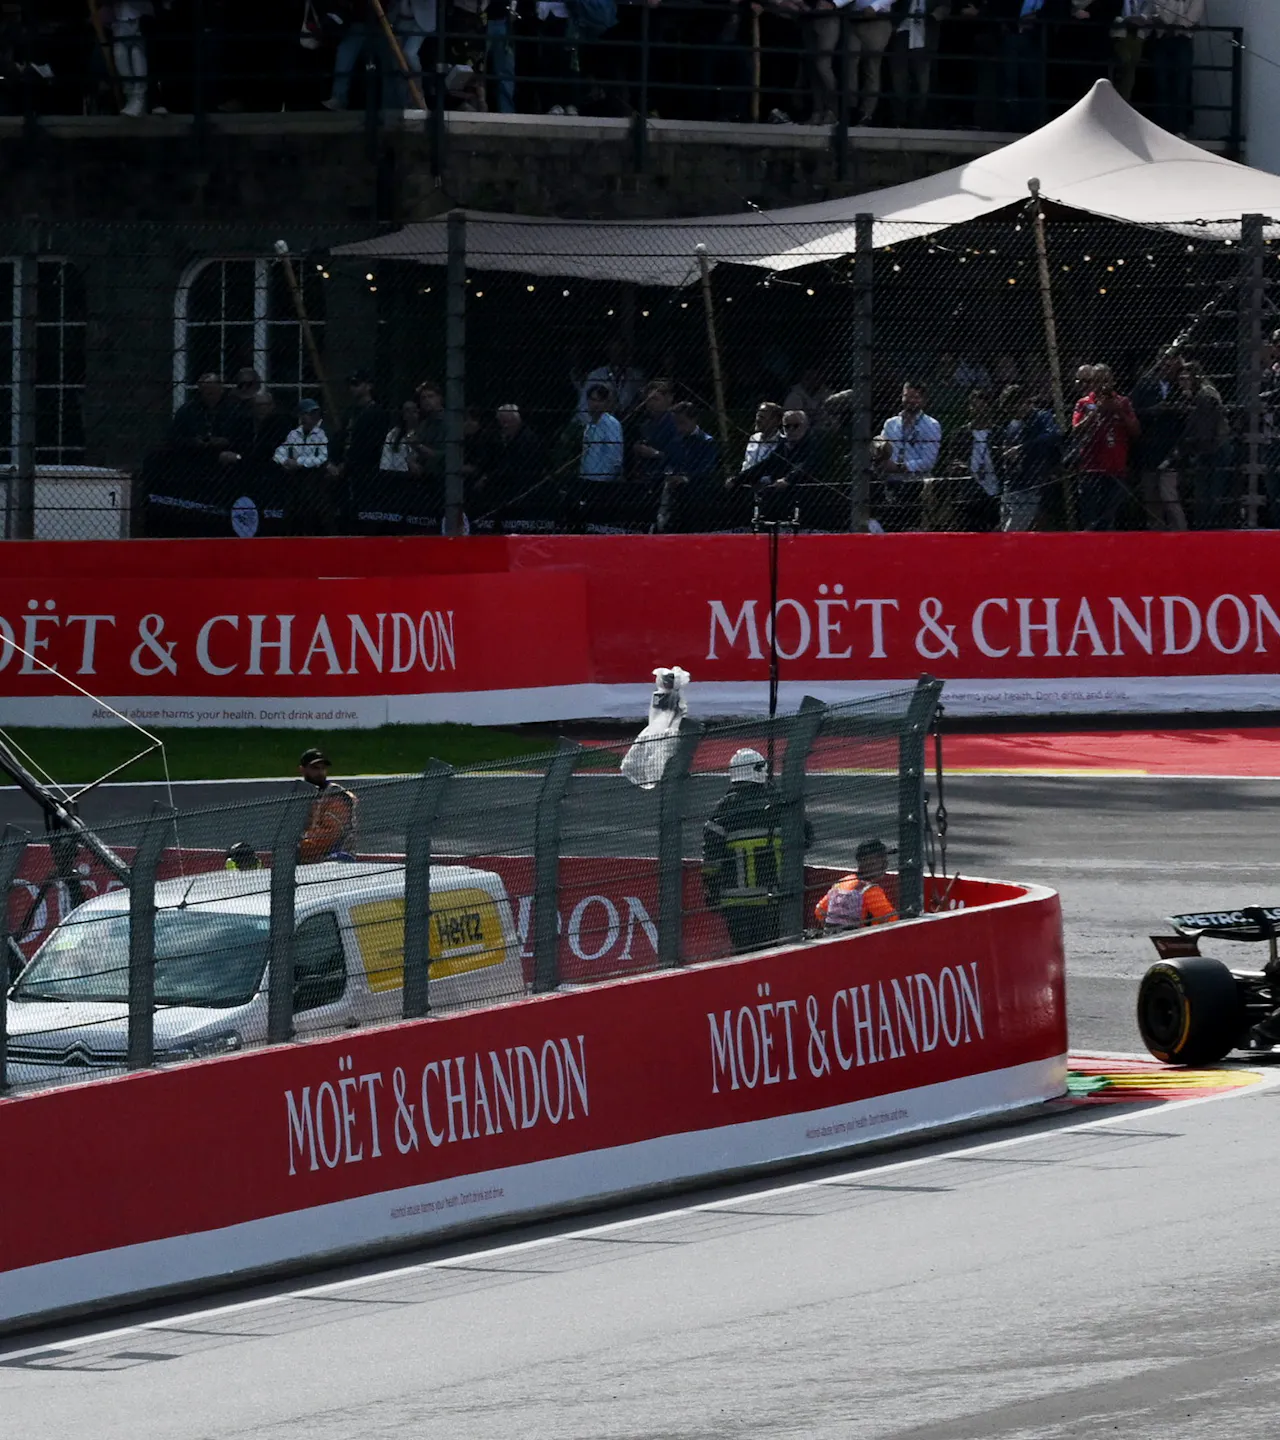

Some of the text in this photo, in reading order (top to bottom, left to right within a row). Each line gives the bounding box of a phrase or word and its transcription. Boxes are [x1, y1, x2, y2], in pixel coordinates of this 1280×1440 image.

[130, 613, 178, 676] &
[196, 610, 457, 676] CHANDON
[706, 584, 898, 660] MOËT
[915, 597, 959, 660] &
[130, 708, 160, 720] abuse
[161, 708, 194, 720] harms
[196, 711, 220, 722] your
[222, 709, 256, 720] health.
[260, 708, 286, 720] Don't
[288, 708, 314, 720] drink
[315, 709, 334, 720] and
[336, 709, 359, 720] drive.
[437, 911, 484, 946] Hertz
[707, 962, 984, 1093] MOËT & CHANDON
[284, 1035, 590, 1176] MOËT & CHANDON
